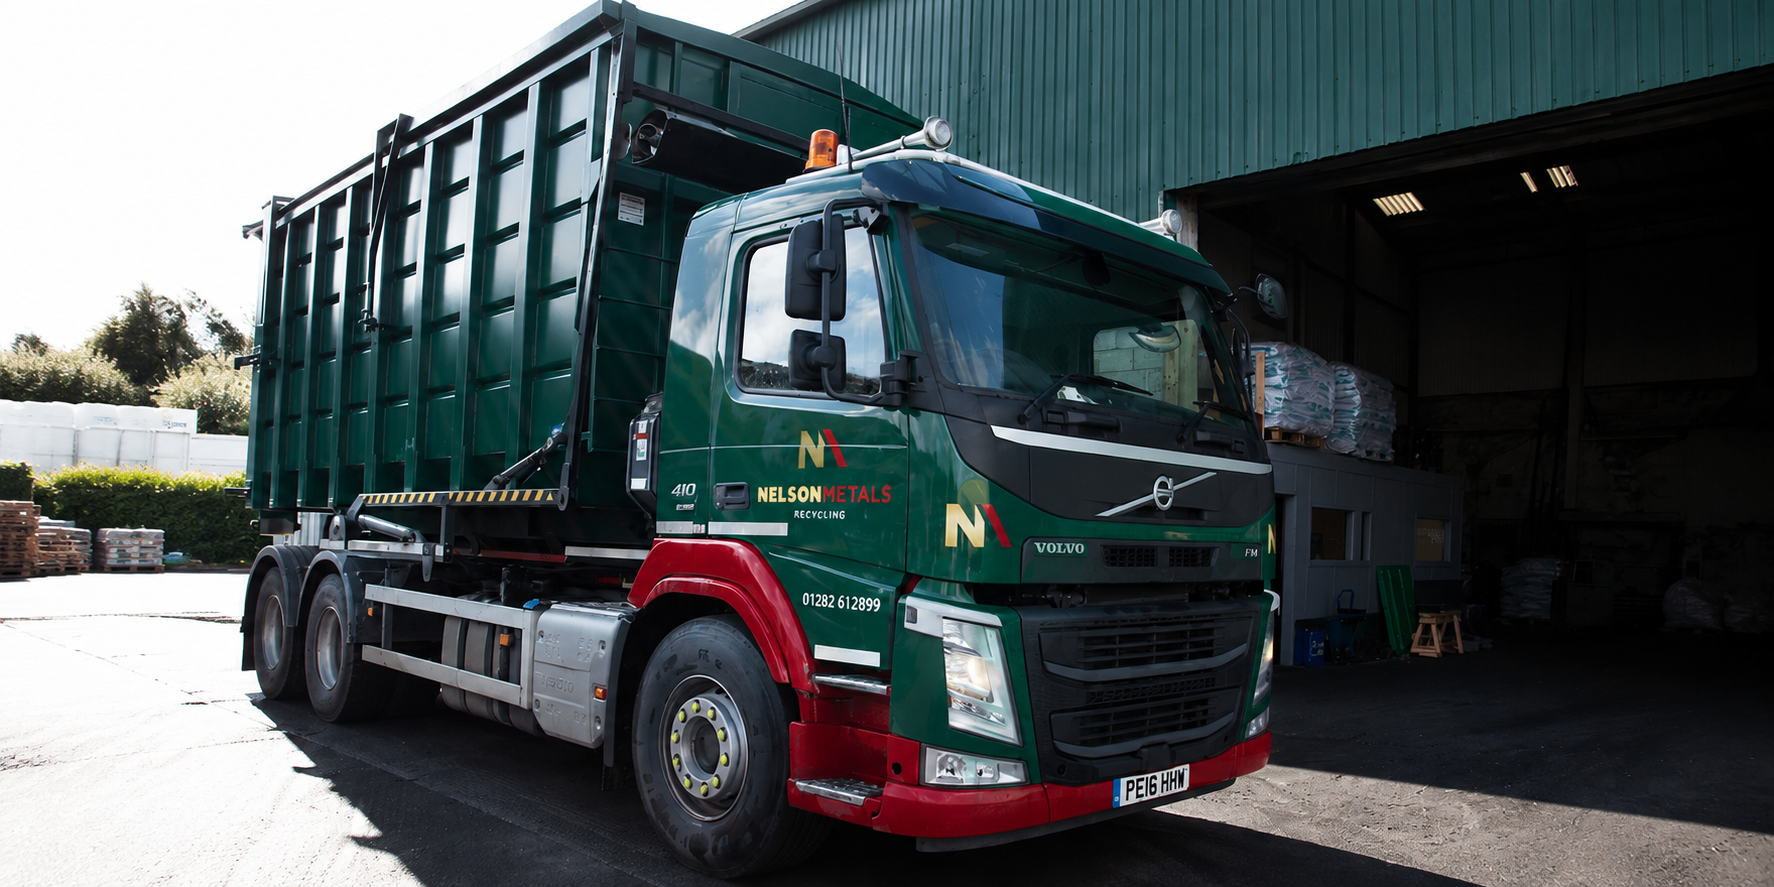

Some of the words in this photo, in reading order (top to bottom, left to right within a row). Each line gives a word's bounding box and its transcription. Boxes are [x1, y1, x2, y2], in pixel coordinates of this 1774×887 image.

[671, 483, 697, 497] 410
[794, 510, 846, 519] RECYCLING
[1034, 542, 1085, 554] VOLVO
[1245, 548, 1258, 557] FM
[802, 592, 835, 608] 01282
[837, 595, 881, 612] 612899
[1126, 775, 1157, 801] PE16
[1161, 768, 1185, 793] HHW
